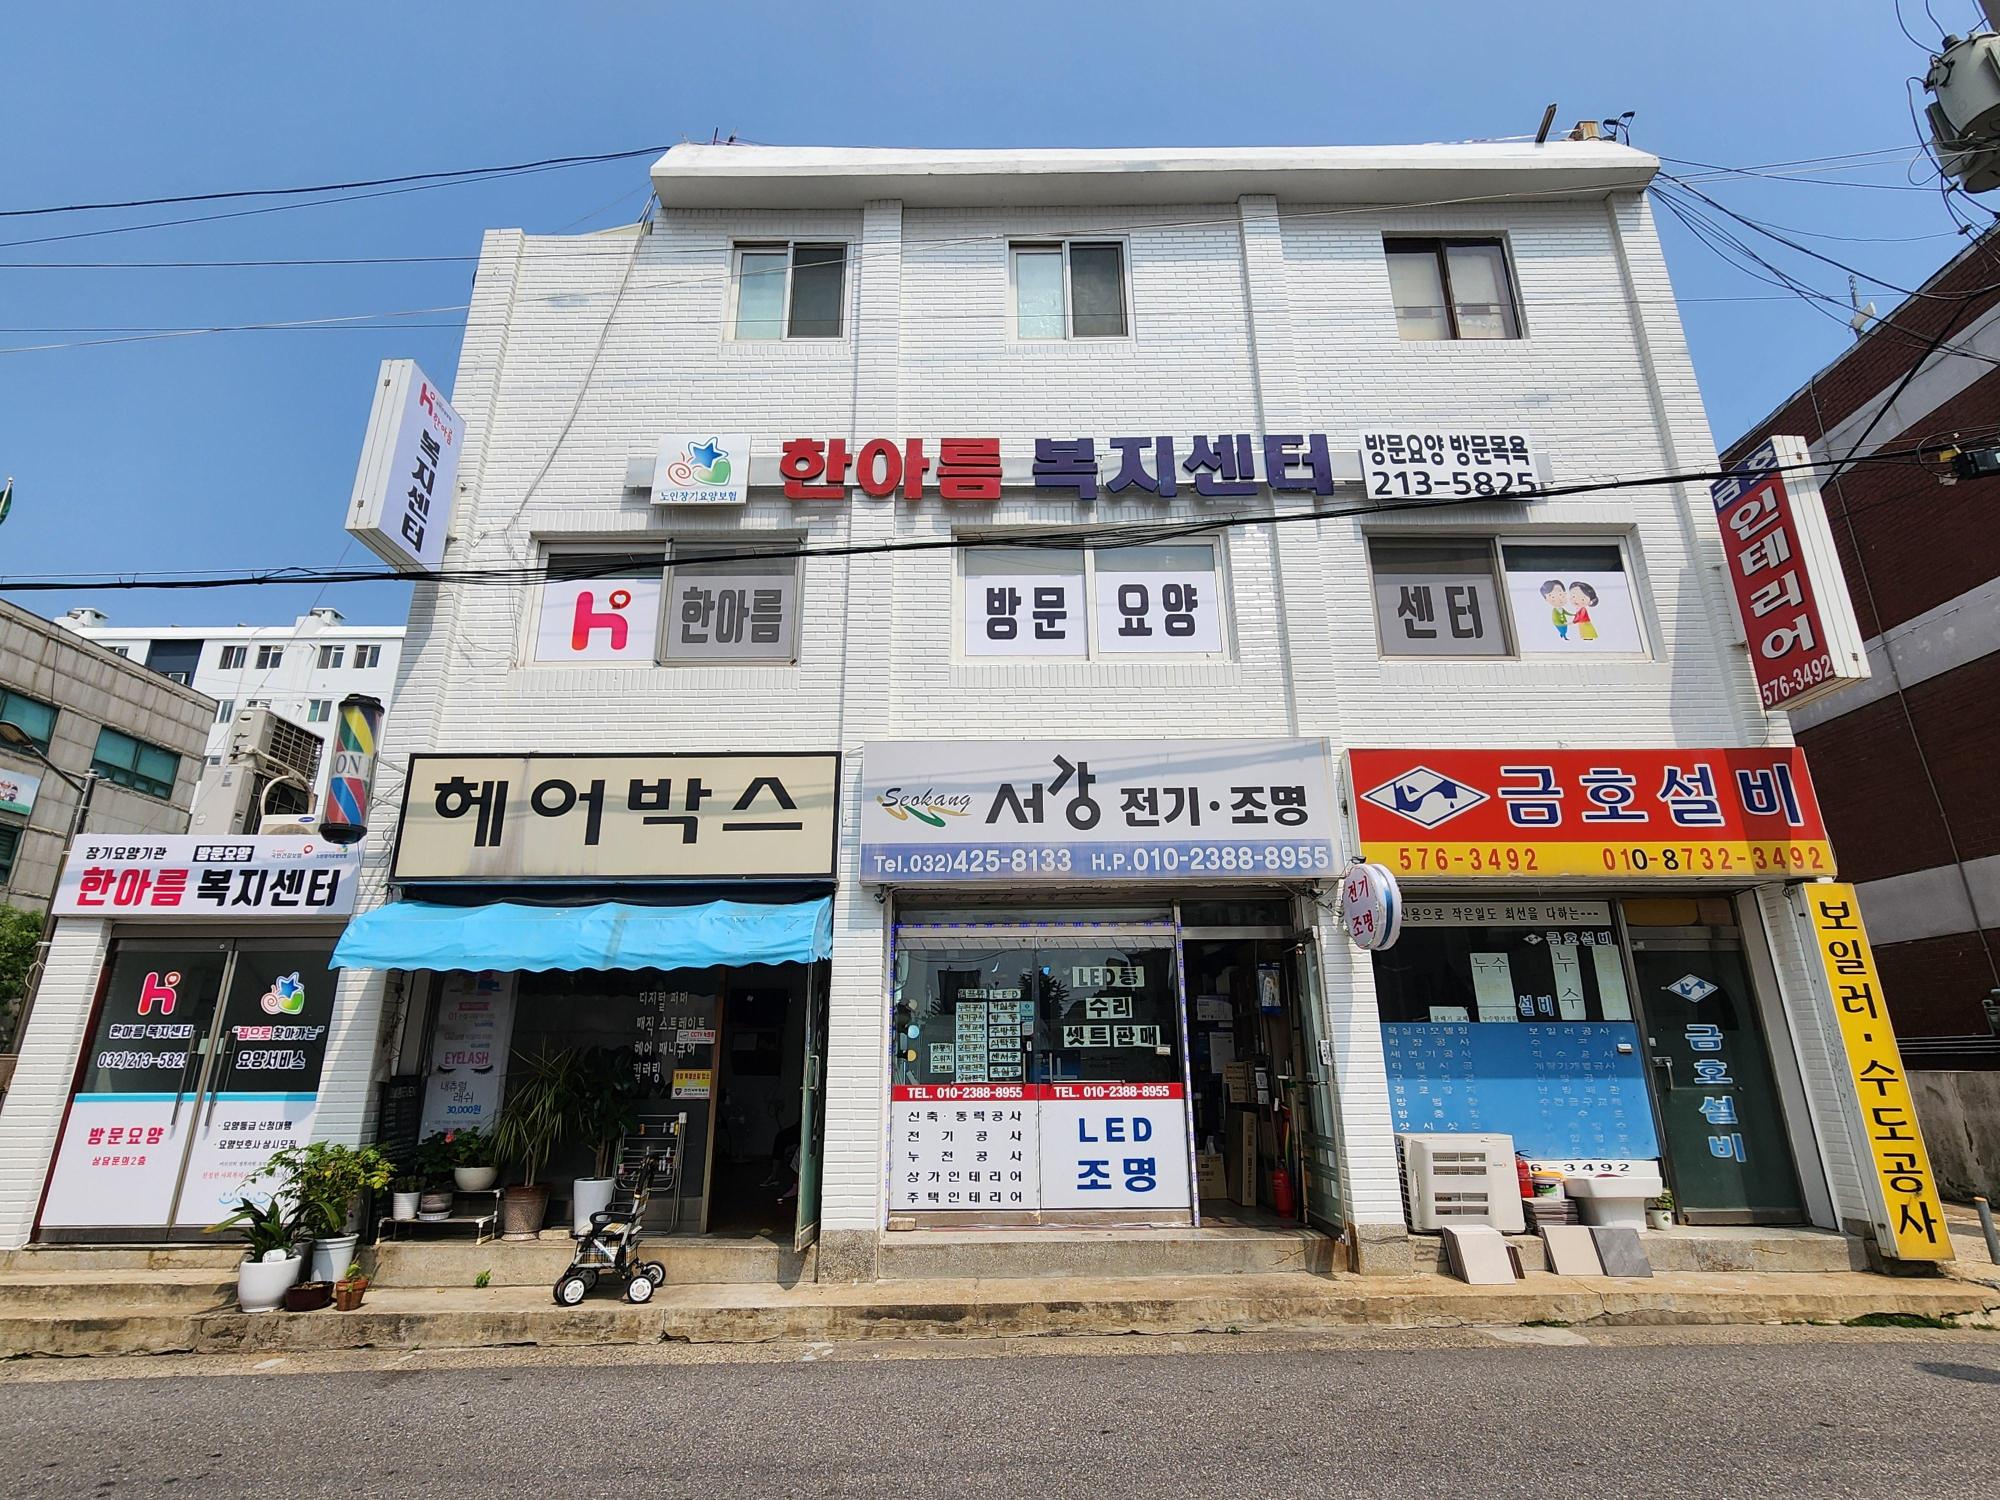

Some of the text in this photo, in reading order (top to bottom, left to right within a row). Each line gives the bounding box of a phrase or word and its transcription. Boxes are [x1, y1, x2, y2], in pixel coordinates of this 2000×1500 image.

[1364, 433, 1531, 467] 방문요양 방문목욕
[779, 433, 1335, 500] 한아름 복지센터
[401, 428, 440, 554] 복지센터
[659, 490, 737, 502] 노인장기요양보험
[1371, 470, 1536, 497] 213-5825
[1728, 486, 1816, 660] 인테리어
[681, 586, 783, 643] 한아름
[986, 583, 1198, 640] 방문 요양
[1397, 585, 1484, 639] 센터
[1762, 653, 1834, 707] 576-3492
[881, 787, 974, 815] Seokang
[984, 754, 1101, 831] 서강
[1496, 762, 1806, 828] 금호설비
[433, 775, 804, 847] 헤어박스
[85, 846, 252, 862] 장기요양기관 방문요양
[1399, 846, 1825, 871] 576-3492 010-8732-3492
[76, 867, 341, 907] 한아름 복지센터
[1347, 875, 1369, 903] 전기
[1352, 909, 1374, 937] 조명
[1451, 907, 1497, 921] 작은일도
[1505, 907, 1539, 921] 최선을
[1545, 931, 1613, 946] 금호설비
[1078, 967, 1138, 987] LED등
[1473, 957, 1508, 974] 누수
[639, 991, 666, 1012] 디지털
[1089, 997, 1130, 1017] 수리
[1519, 994, 1554, 1017] 설비
[109, 1024, 194, 1040] 한아름 복지센터
[659, 1016, 705, 1030] 스트레이트
[235, 1050, 306, 1070] 요양서비스
[444, 1051, 490, 1065] EYELASH
[634, 1041, 653, 1056] 헤어
[453, 1091, 474, 1104] 래쉬
[907, 1086, 1023, 1099] TEL. 010-2388-8955
[1053, 1085, 1170, 1098] TEL. 010-2388-8955
[1684, 1023, 1747, 1163] 금호설비
[446, 1104, 482, 1115] 30,000원
[1078, 1117, 1152, 1143] LED
[1076, 1156, 1157, 1193] 조명
